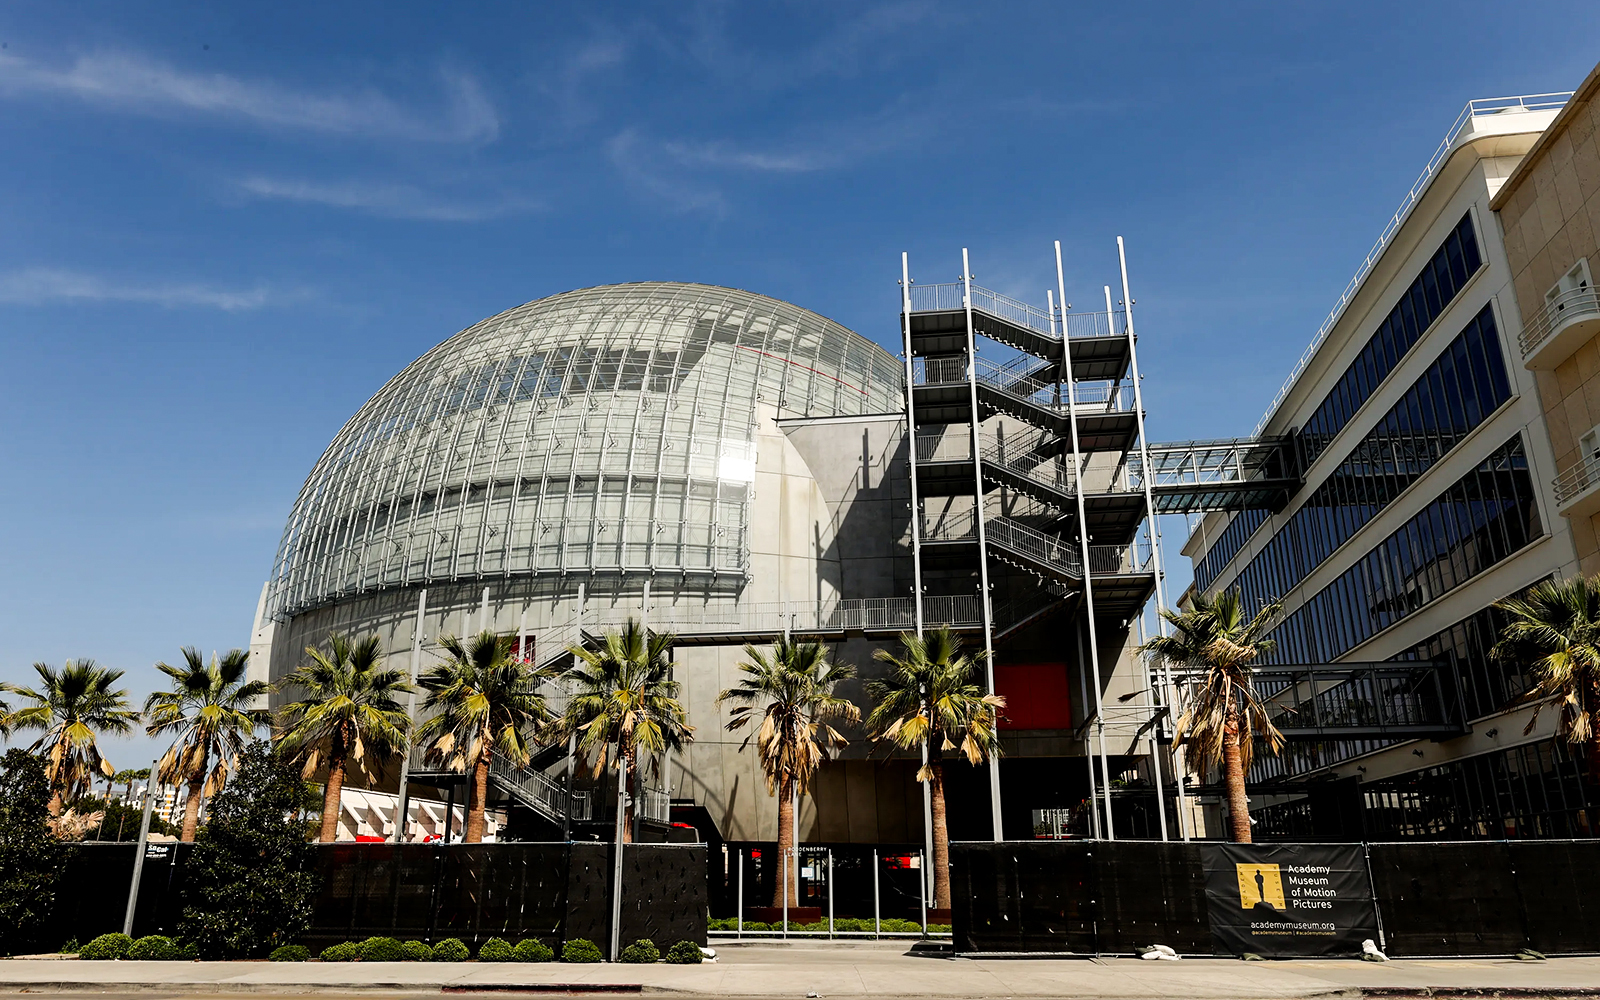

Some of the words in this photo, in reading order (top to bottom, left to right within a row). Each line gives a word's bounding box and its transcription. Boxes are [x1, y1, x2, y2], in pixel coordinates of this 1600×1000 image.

[1288, 864, 1331, 875] Academy
[1288, 876, 1329, 885] Museum
[1291, 887, 1301, 897] of
[1303, 887, 1337, 897] Motion
[1292, 899, 1333, 909] Pictures
[1250, 921, 1336, 930] academymuseum.org
